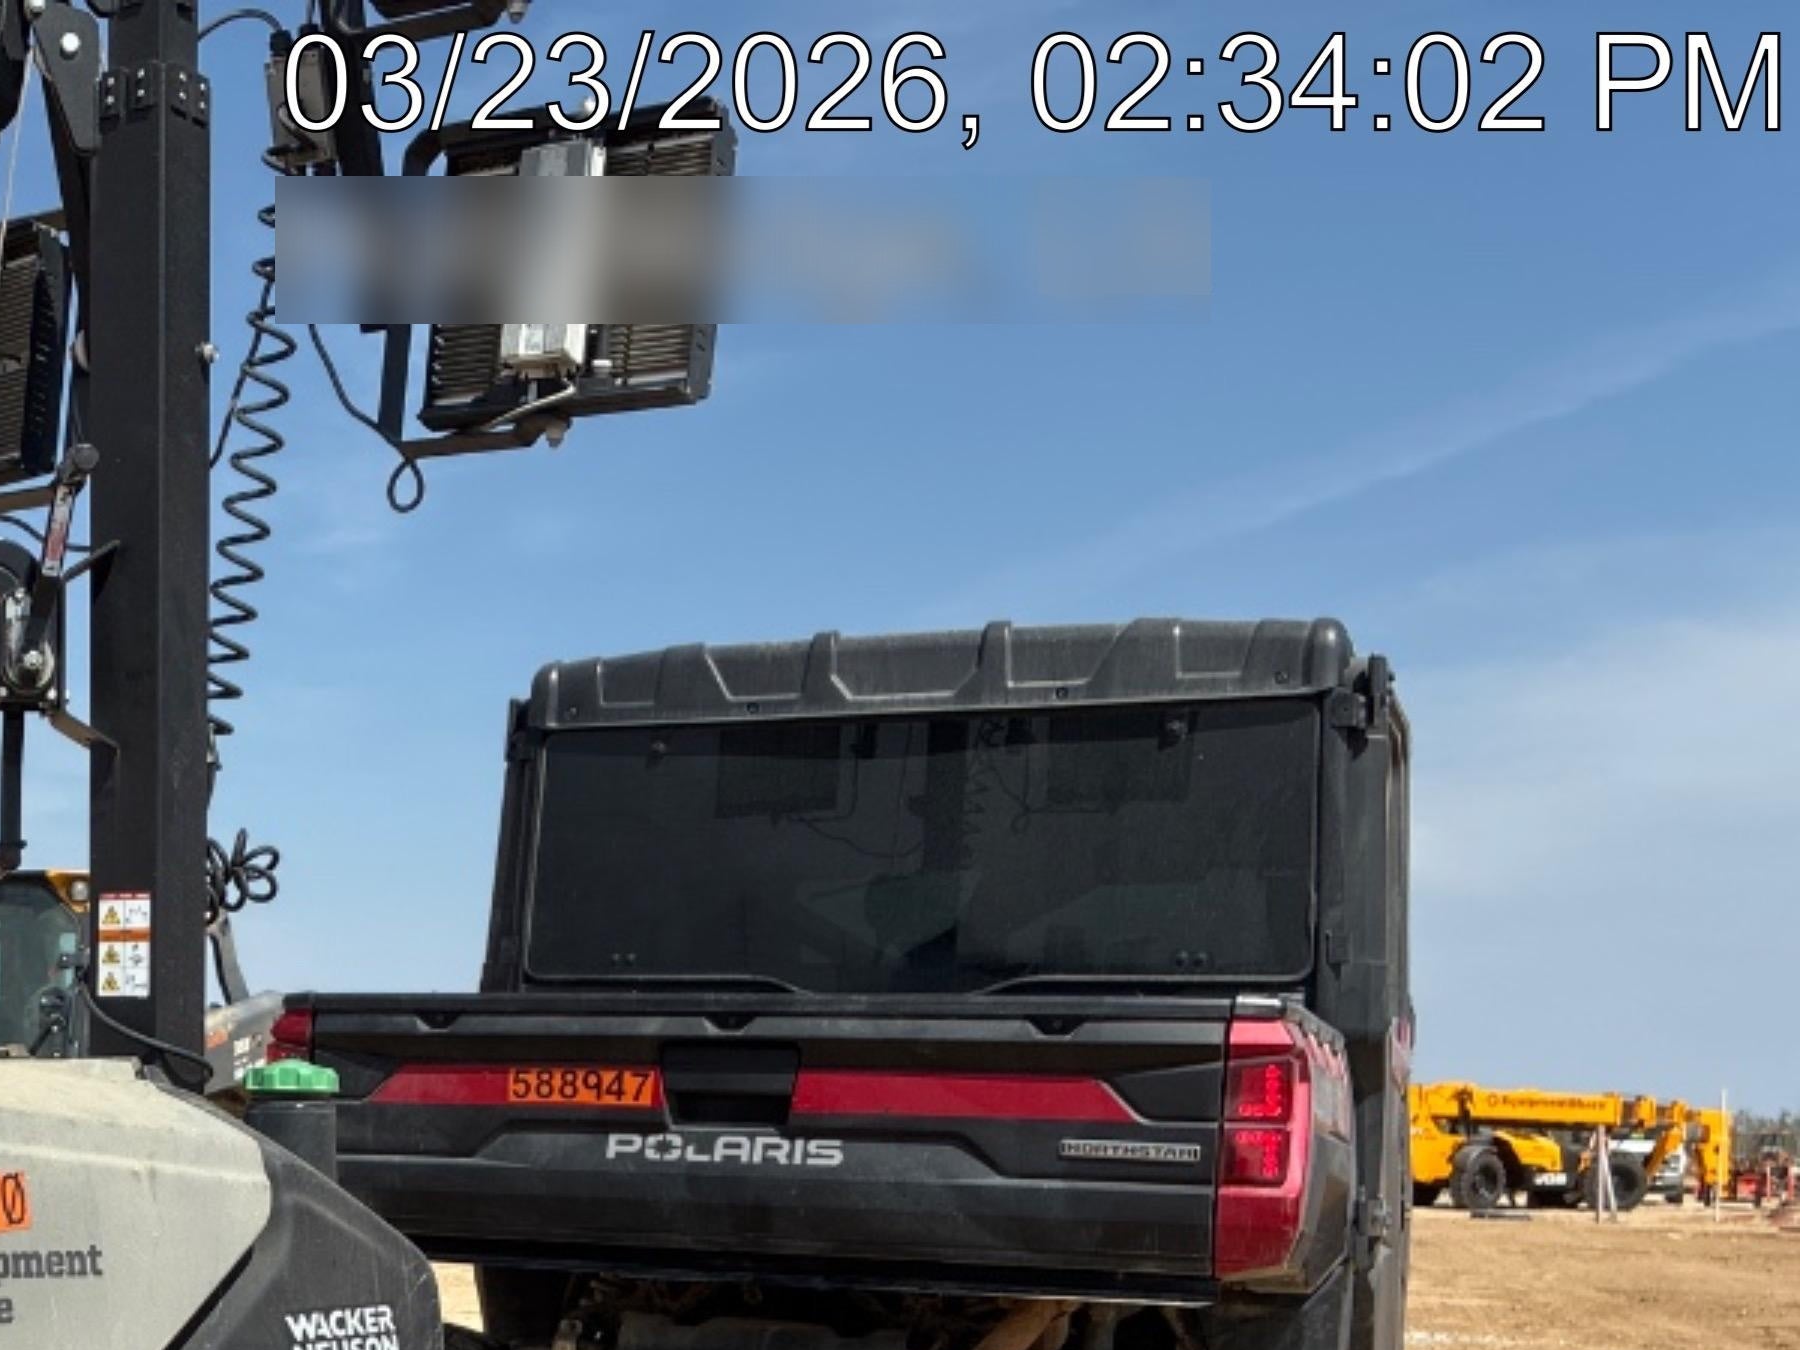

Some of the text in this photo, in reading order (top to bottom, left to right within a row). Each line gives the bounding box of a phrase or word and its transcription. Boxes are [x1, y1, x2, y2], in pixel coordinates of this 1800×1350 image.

[511, 1070, 651, 1101] 588947
[606, 1133, 843, 1166] POLARIS
[285, 1304, 396, 1342] WACKER
